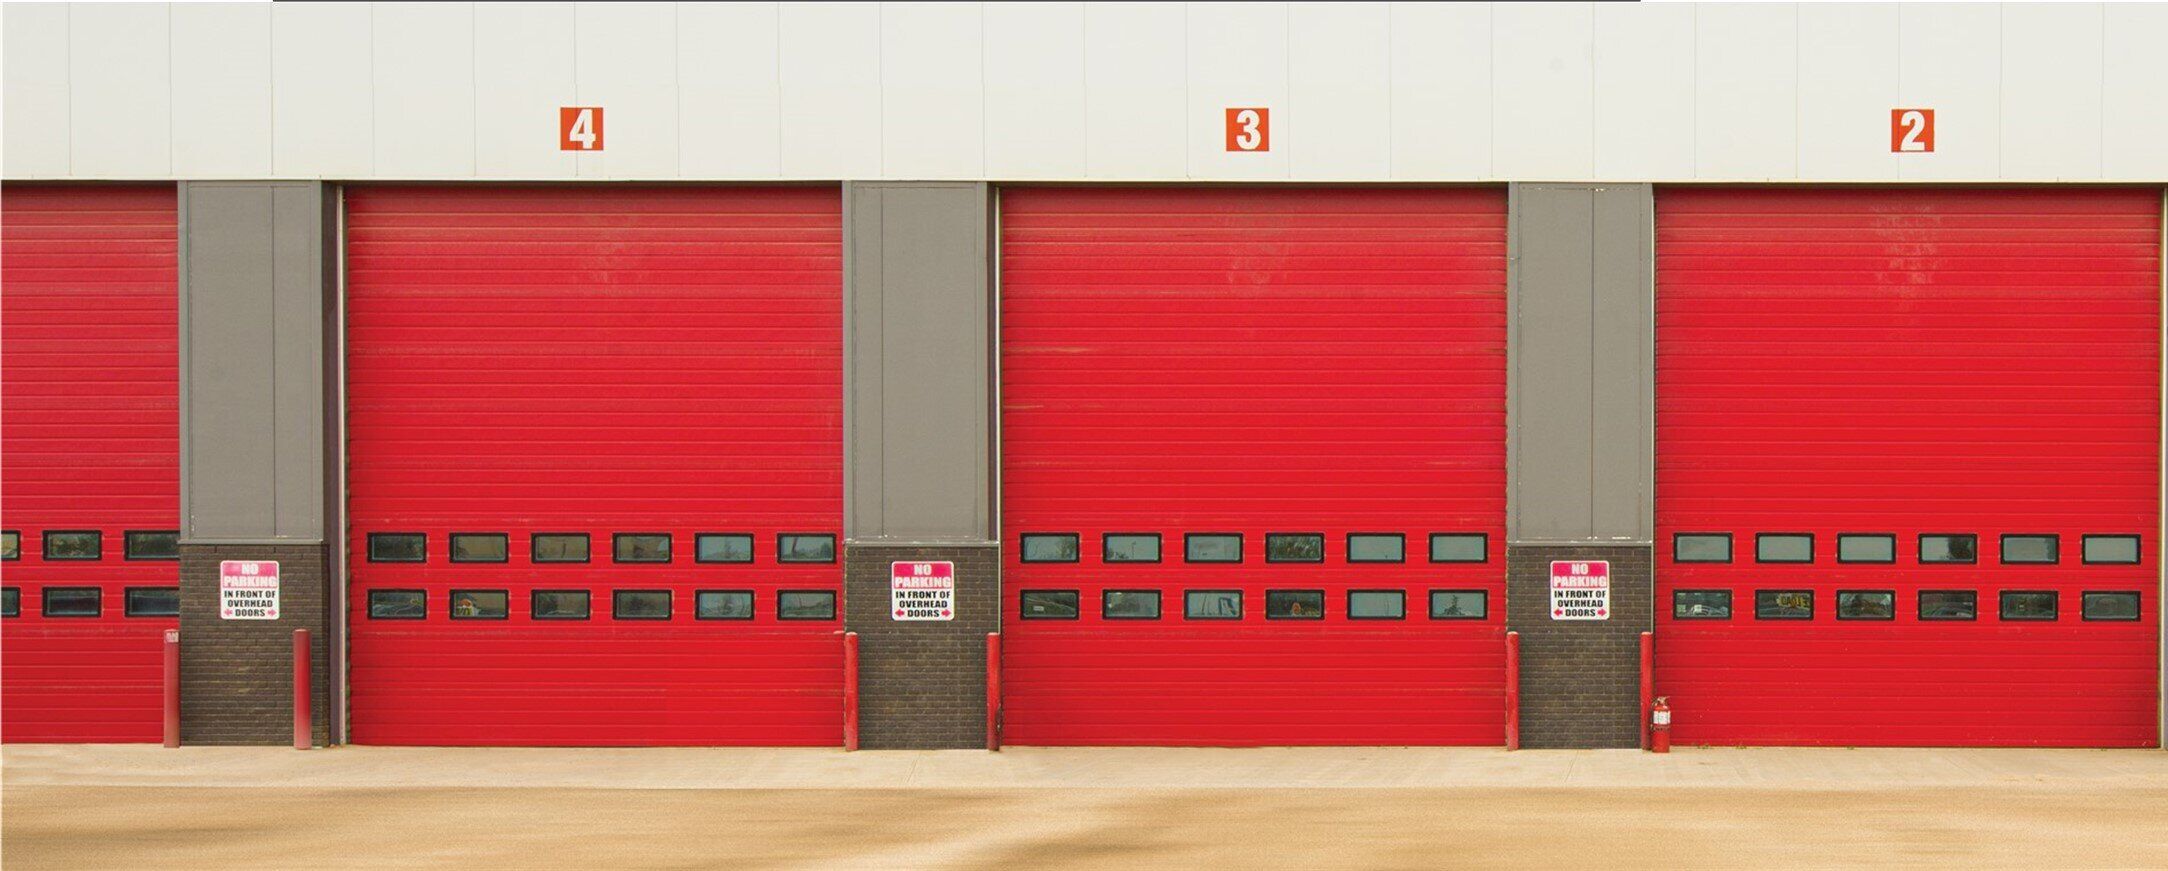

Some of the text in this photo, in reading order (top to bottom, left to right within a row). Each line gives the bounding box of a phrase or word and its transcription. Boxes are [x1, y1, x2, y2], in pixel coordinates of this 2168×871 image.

[569, 108, 596, 149] 4
[1236, 109, 1261, 150] 3
[1900, 110, 1925, 151] 2
[241, 563, 259, 575] NO
[913, 564, 932, 576] NO
[1571, 563, 1589, 575] NO
[224, 575, 277, 587] PARKING
[894, 576, 951, 588] PARKING
[1553, 575, 1607, 587] PARKING
[224, 590, 276, 598] IN FRONT OF
[895, 591, 951, 599] IN FRONT OF
[1554, 590, 1606, 598] IN FRONT OF
[227, 599, 273, 608] OVERHEAD
[899, 600, 948, 608] OVERHEAD
[1557, 599, 1604, 608] OVERHEAD
[235, 608, 266, 617] DOORS
[907, 609, 940, 618] DOORS
[1565, 608, 1596, 617] DOORS
